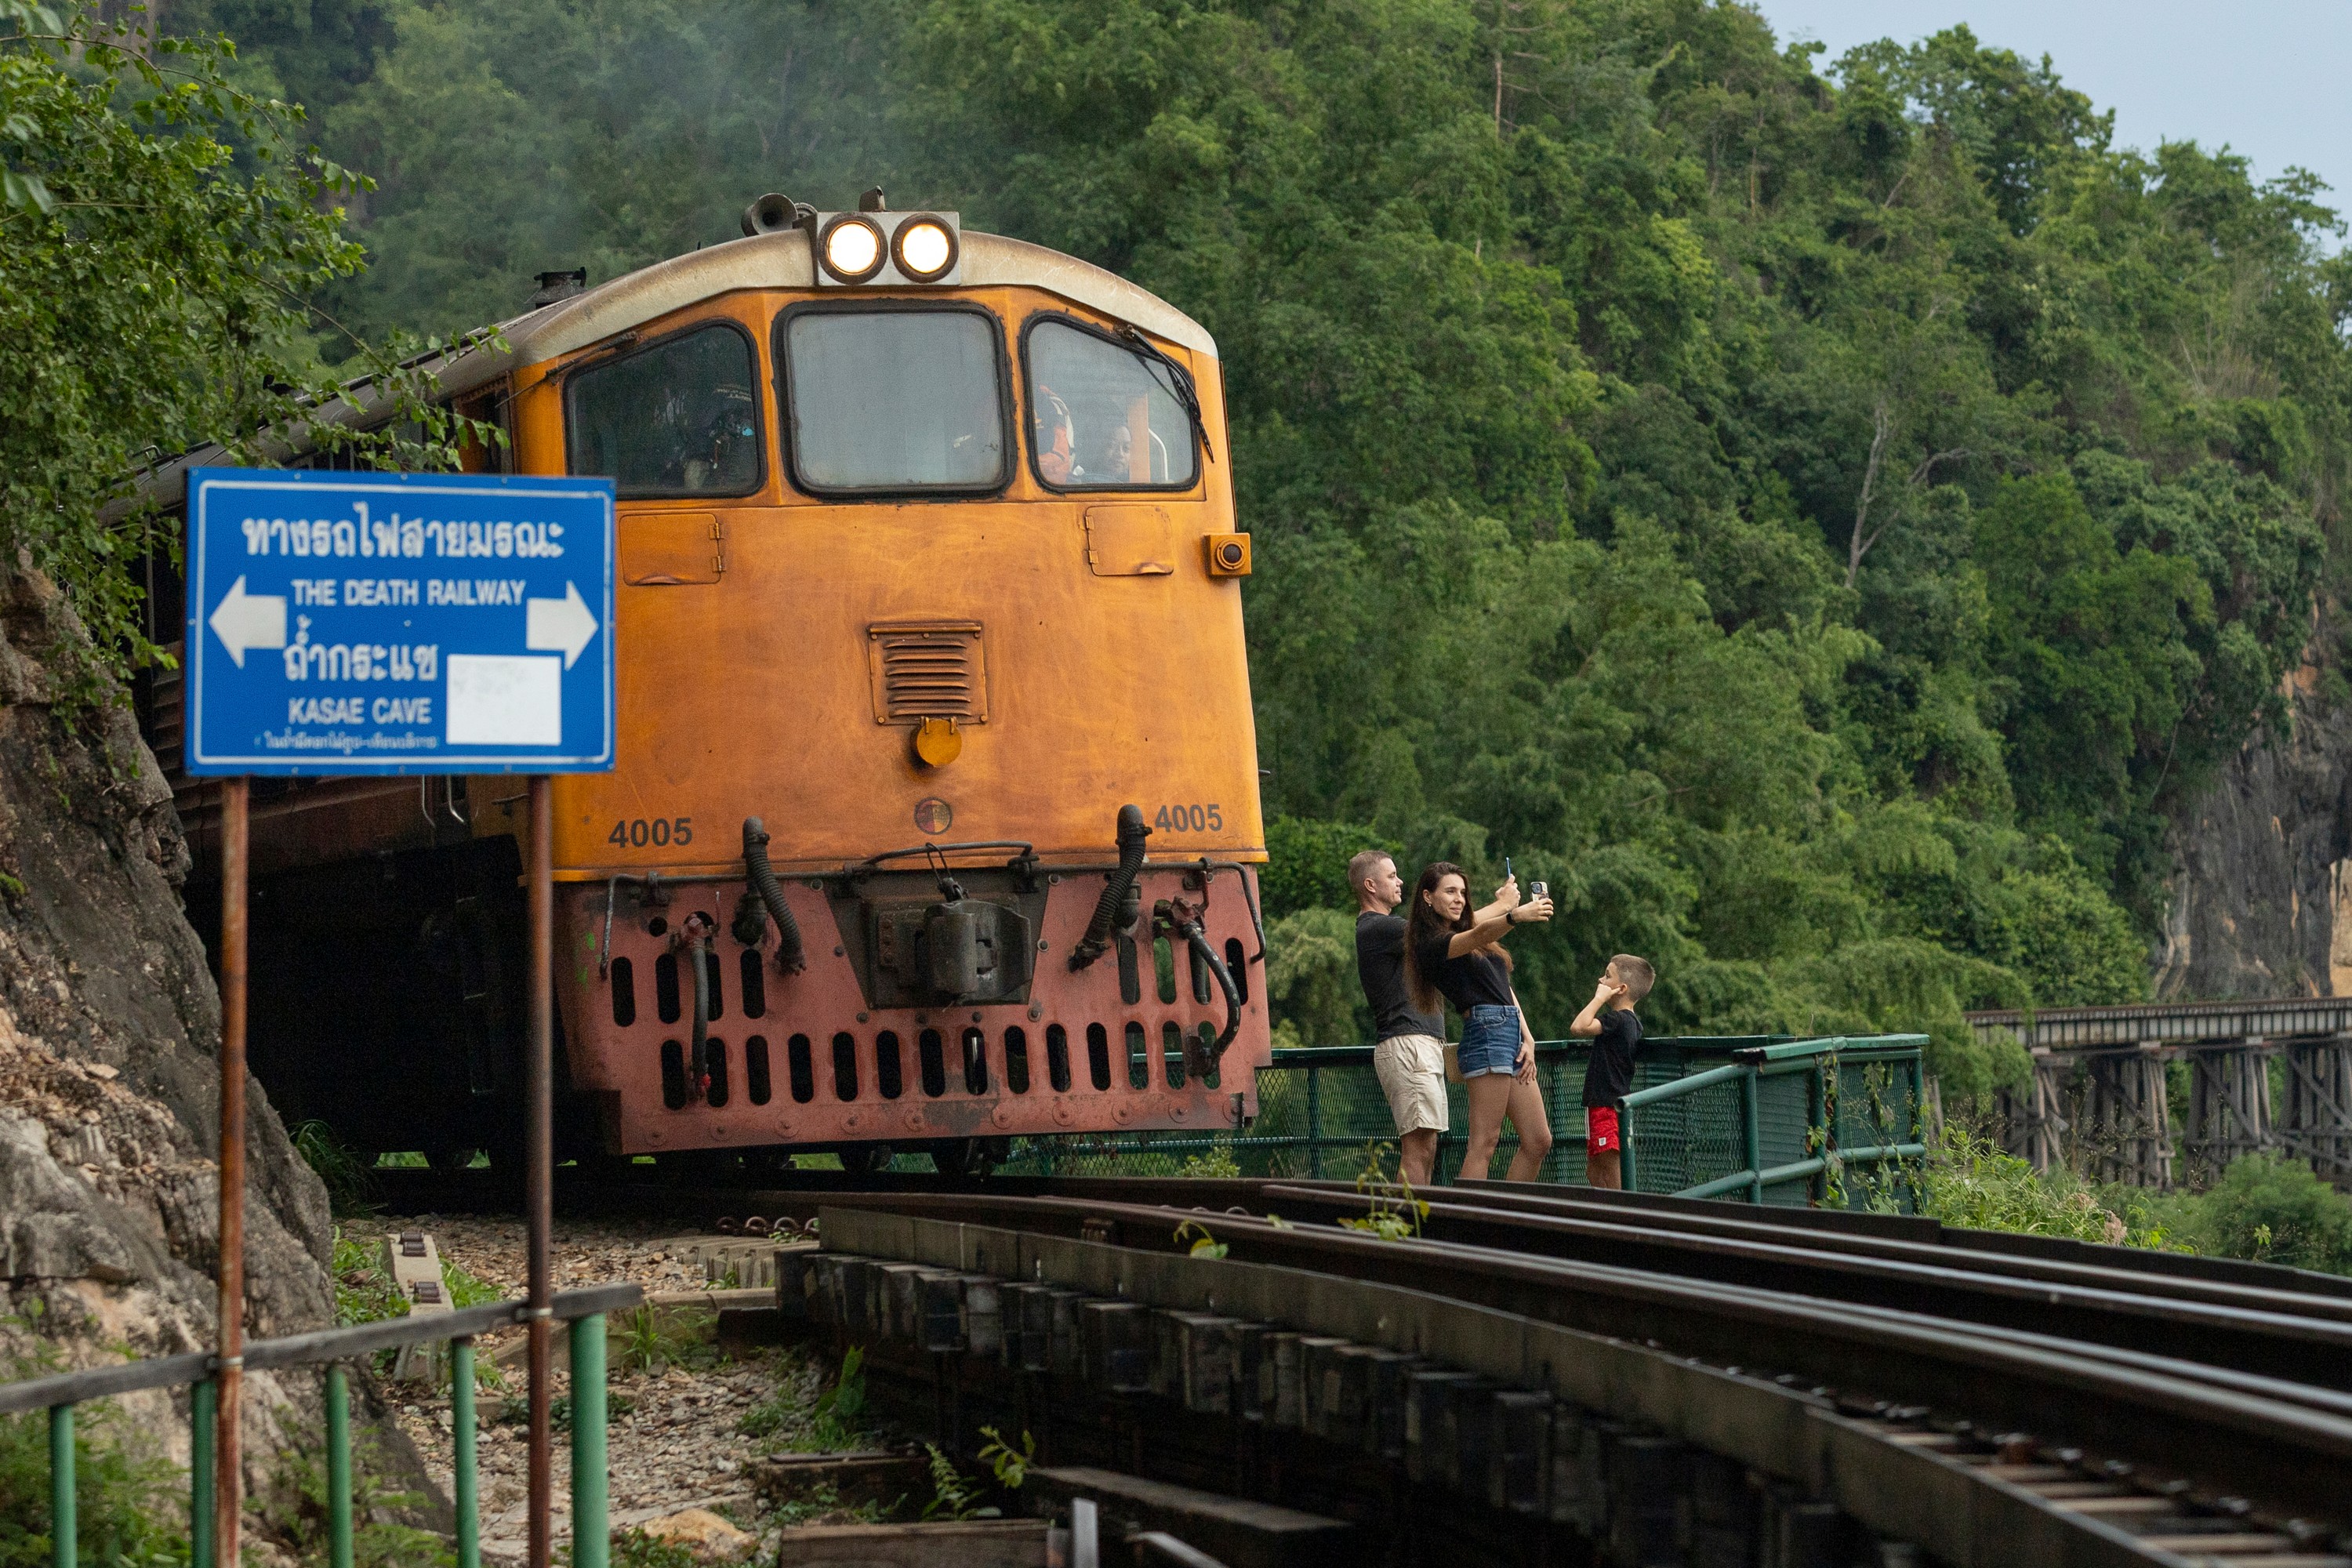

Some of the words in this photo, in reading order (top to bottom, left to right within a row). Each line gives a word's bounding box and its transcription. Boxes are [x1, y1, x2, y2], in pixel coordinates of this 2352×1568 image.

[241, 501, 564, 558] ทางรถไฟสายมรณะ
[291, 579, 336, 606] THE
[343, 579, 419, 607] DEATH
[426, 579, 526, 607] RAILWAY
[289, 697, 365, 724] KASAE
[372, 697, 432, 724] CAVE
[608, 817, 692, 848] 4005
[1155, 804, 1223, 833] 4005
